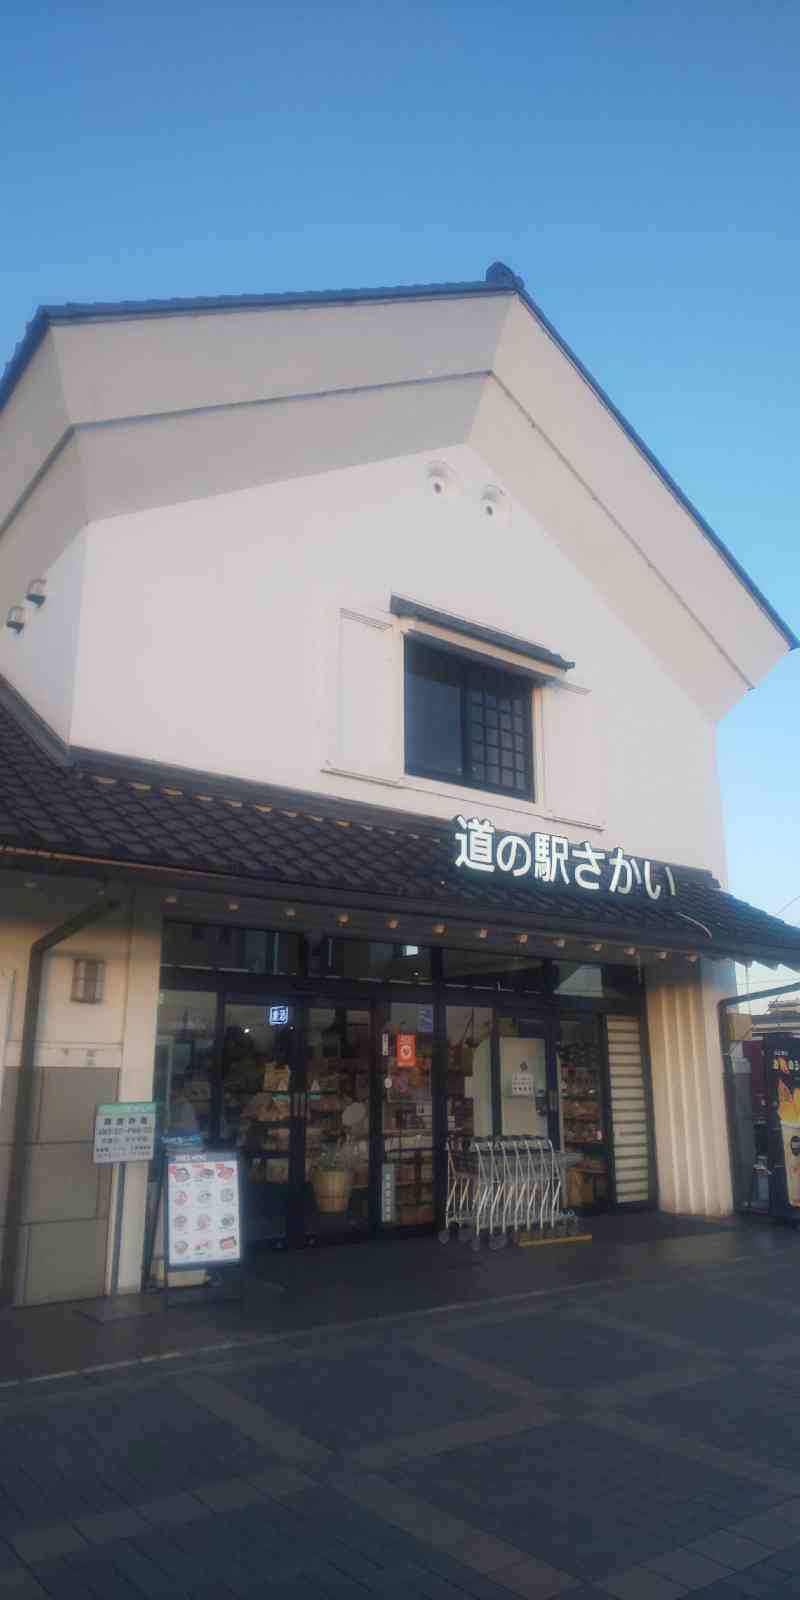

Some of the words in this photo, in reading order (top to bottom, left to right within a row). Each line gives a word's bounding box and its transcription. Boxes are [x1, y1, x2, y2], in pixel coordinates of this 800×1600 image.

[454, 814, 677, 900] 道の駅さかい
